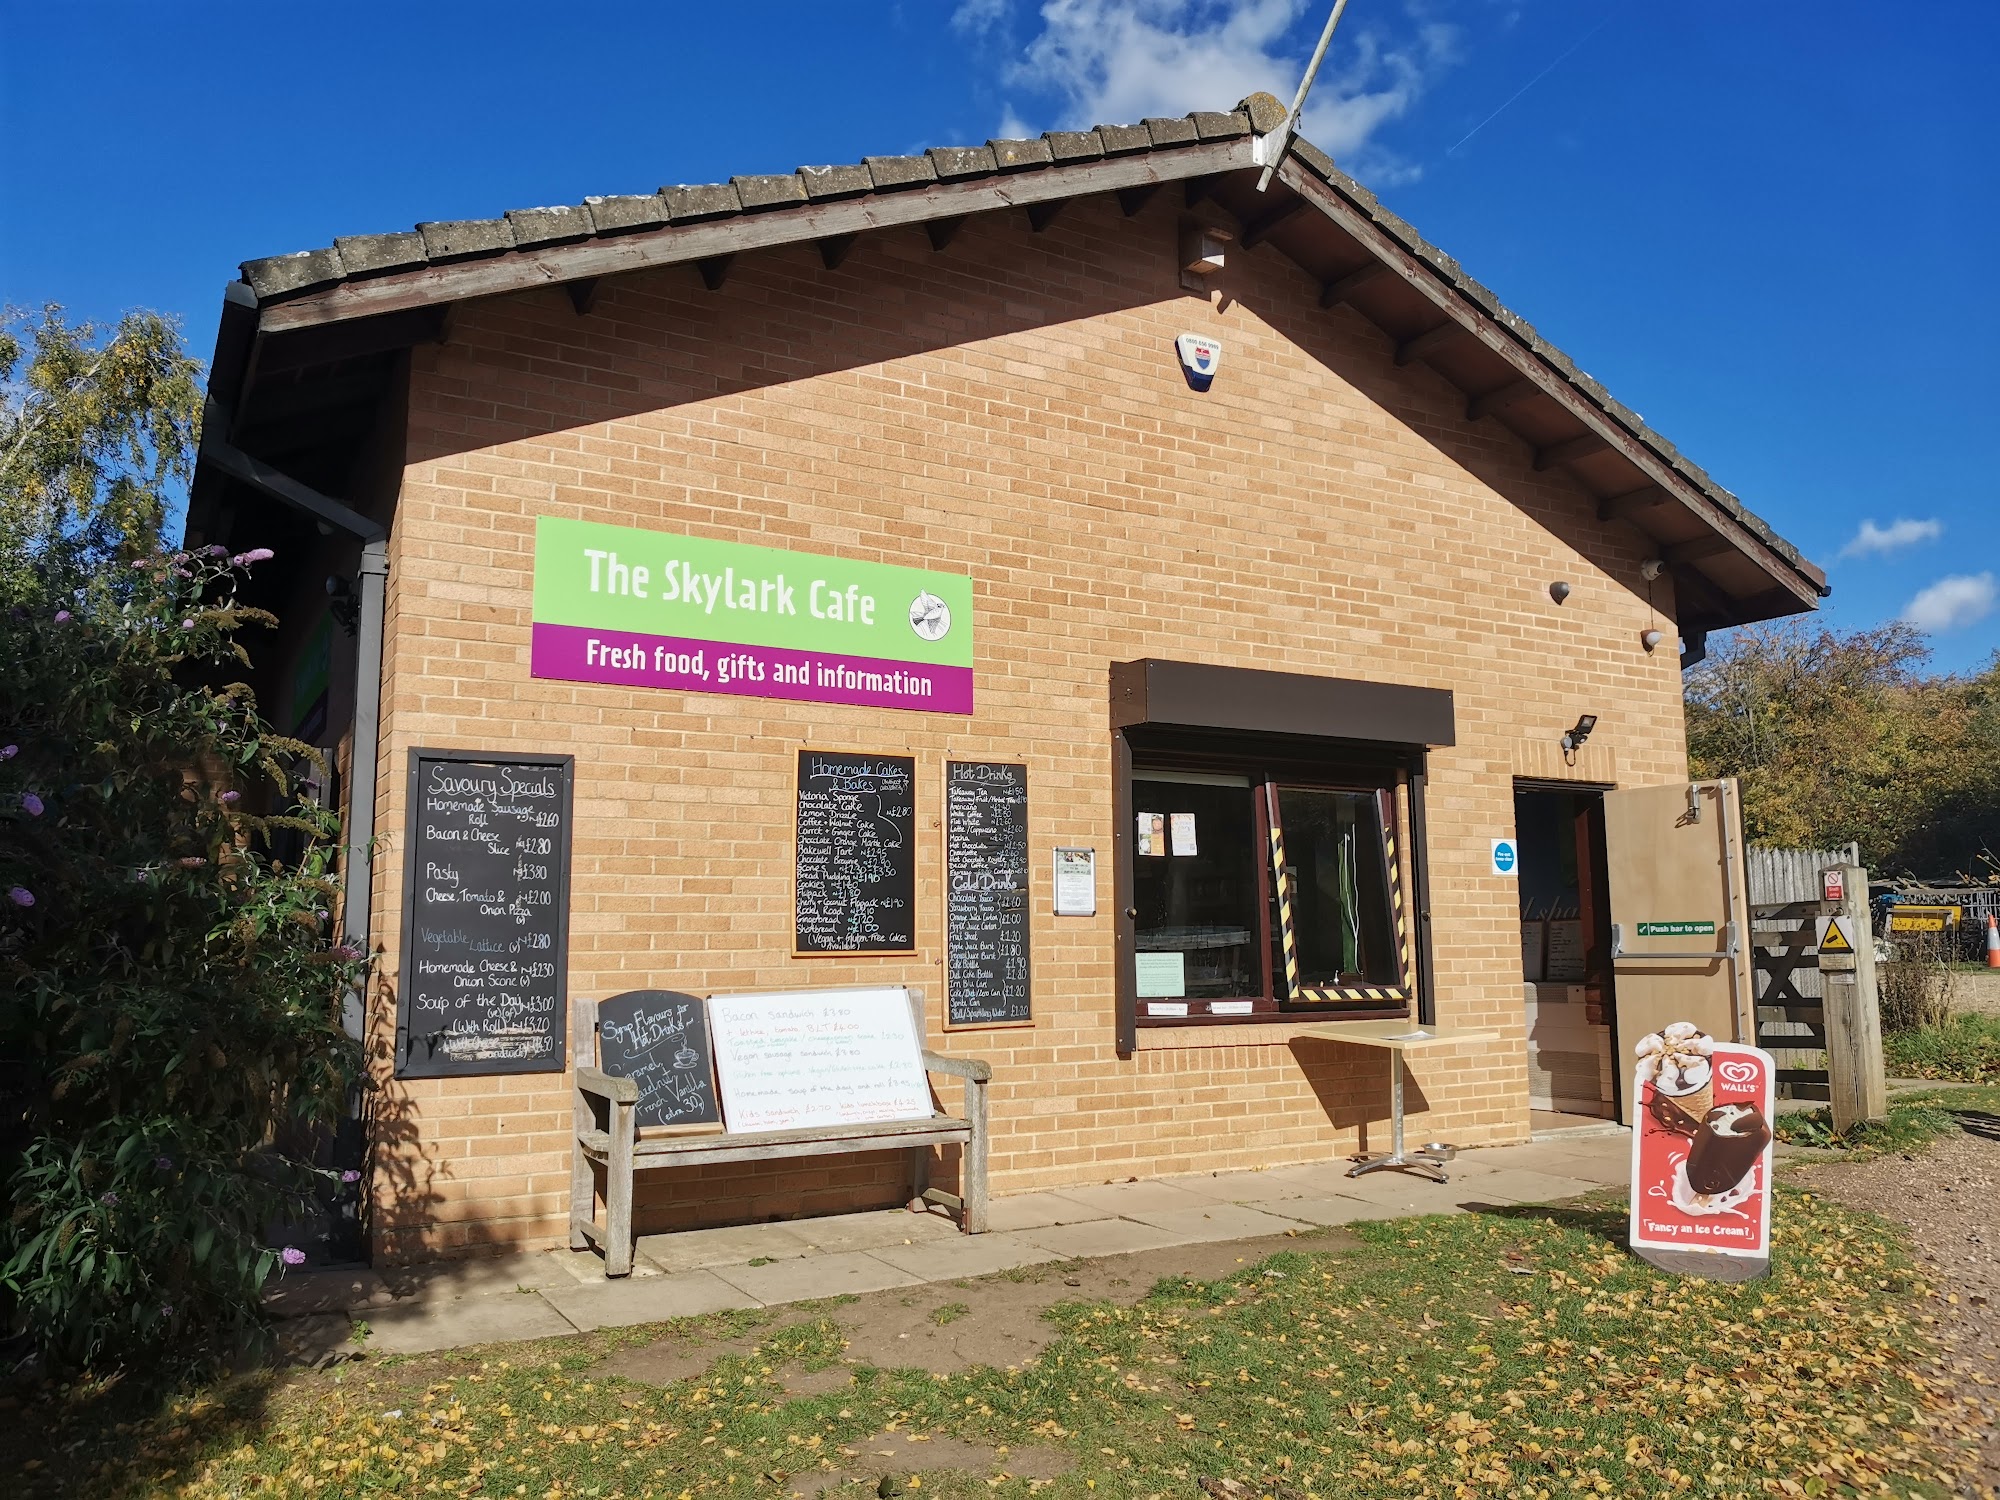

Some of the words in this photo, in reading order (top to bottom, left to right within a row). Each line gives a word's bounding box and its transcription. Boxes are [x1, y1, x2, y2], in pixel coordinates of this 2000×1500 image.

[584, 549, 649, 598] The
[662, 559, 796, 617] Skylark
[810, 580, 875, 625] Cafe
[587, 639, 646, 670] Fresh
[654, 646, 709, 681] food,
[718, 653, 765, 683] gifts
[773, 662, 809, 685] and
[817, 662, 932, 696] information
[812, 757, 871, 775] Homemade
[876, 762, 903, 775] Cakes
[953, 764, 975, 779] Hot
[977, 765, 1013, 780] Drinks
[429, 766, 496, 804] Savoury
[500, 767, 554, 802] Specials
[832, 778, 839, 789] &
[843, 778, 874, 790] Bakes
[799, 790, 829, 800] Victoria
[833, 791, 860, 803] Sponge
[427, 798, 485, 813] Homemade
[492, 803, 535, 822] Sausage
[799, 801, 838, 810] Chocolate
[841, 802, 864, 812] Cake
[469, 814, 488, 827] Roll
[799, 809, 827, 818] Lemon
[829, 811, 858, 820] Drizzle
[798, 818, 824, 826] Coffee
[857, 820, 875, 829] Cake
[426, 825, 460, 840] Bacon
[462, 830, 468, 840] &
[471, 828, 500, 842] Cheese
[798, 826, 823, 835] Carrot
[831, 828, 856, 839] Ginger
[858, 829, 878, 838] Cake
[488, 842, 510, 855] Slice
[797, 836, 832, 844] Chocolate
[834, 837, 858, 847] Orange
[884, 839, 902, 848] Cake
[798, 843, 831, 855] Bakewell
[834, 846, 853, 855] Tart
[797, 855, 829, 863] Chocolate
[834, 856, 858, 864] Brownie
[797, 864, 826, 872] Scones
[427, 862, 459, 888] Pasty
[797, 872, 819, 880] Bread
[823, 872, 851, 882] Pudding
[797, 880, 825, 888] Cookies
[952, 875, 978, 890] Cold
[979, 874, 1017, 891] Drinks
[460, 888, 495, 902] Tomato
[498, 890, 505, 902] &
[949, 893, 976, 902] Chocolate
[480, 904, 506, 916] Onion
[509, 904, 532, 916] Pizza
[823, 907, 844, 915] Road
[797, 924, 837, 934] Shortbread
[1694, 925, 1713, 933] open
[421, 928, 469, 951] Vegetable
[889, 933, 907, 942] Cakes
[949, 932, 962, 940] Fruit
[964, 932, 978, 940] Shoot
[470, 939, 505, 952] Lattice
[509, 941, 520, 953] (v)
[419, 960, 475, 974] Homemade
[480, 959, 509, 972] Cheese
[510, 961, 518, 972] &
[454, 976, 484, 987] Onion
[488, 975, 517, 987] Scone
[520, 976, 530, 987] (v)
[417, 993, 449, 1015] Soup
[455, 994, 471, 1008] of
[476, 993, 496, 1006] the
[500, 993, 522, 1015] Day
[722, 1008, 759, 1023] Bacon
[601, 1020, 633, 1043] Syrup
[634, 1009, 672, 1030] Flavours
[677, 1004, 689, 1022] for
[632, 1028, 651, 1050] Hot
[650, 1018, 684, 1042] Drinks
[730, 1049, 759, 1065] Vegan
[634, 1091, 668, 1116] French
[665, 1072, 706, 1101] Vanilla
[1721, 1082, 1756, 1093] WALL'S
[738, 1109, 760, 1119] Kids
[1648, 1221, 1677, 1236] Fancy
[1680, 1225, 1693, 1234] an
[1695, 1224, 1711, 1234] Ice
[1712, 1224, 1750, 1236] Cream?
